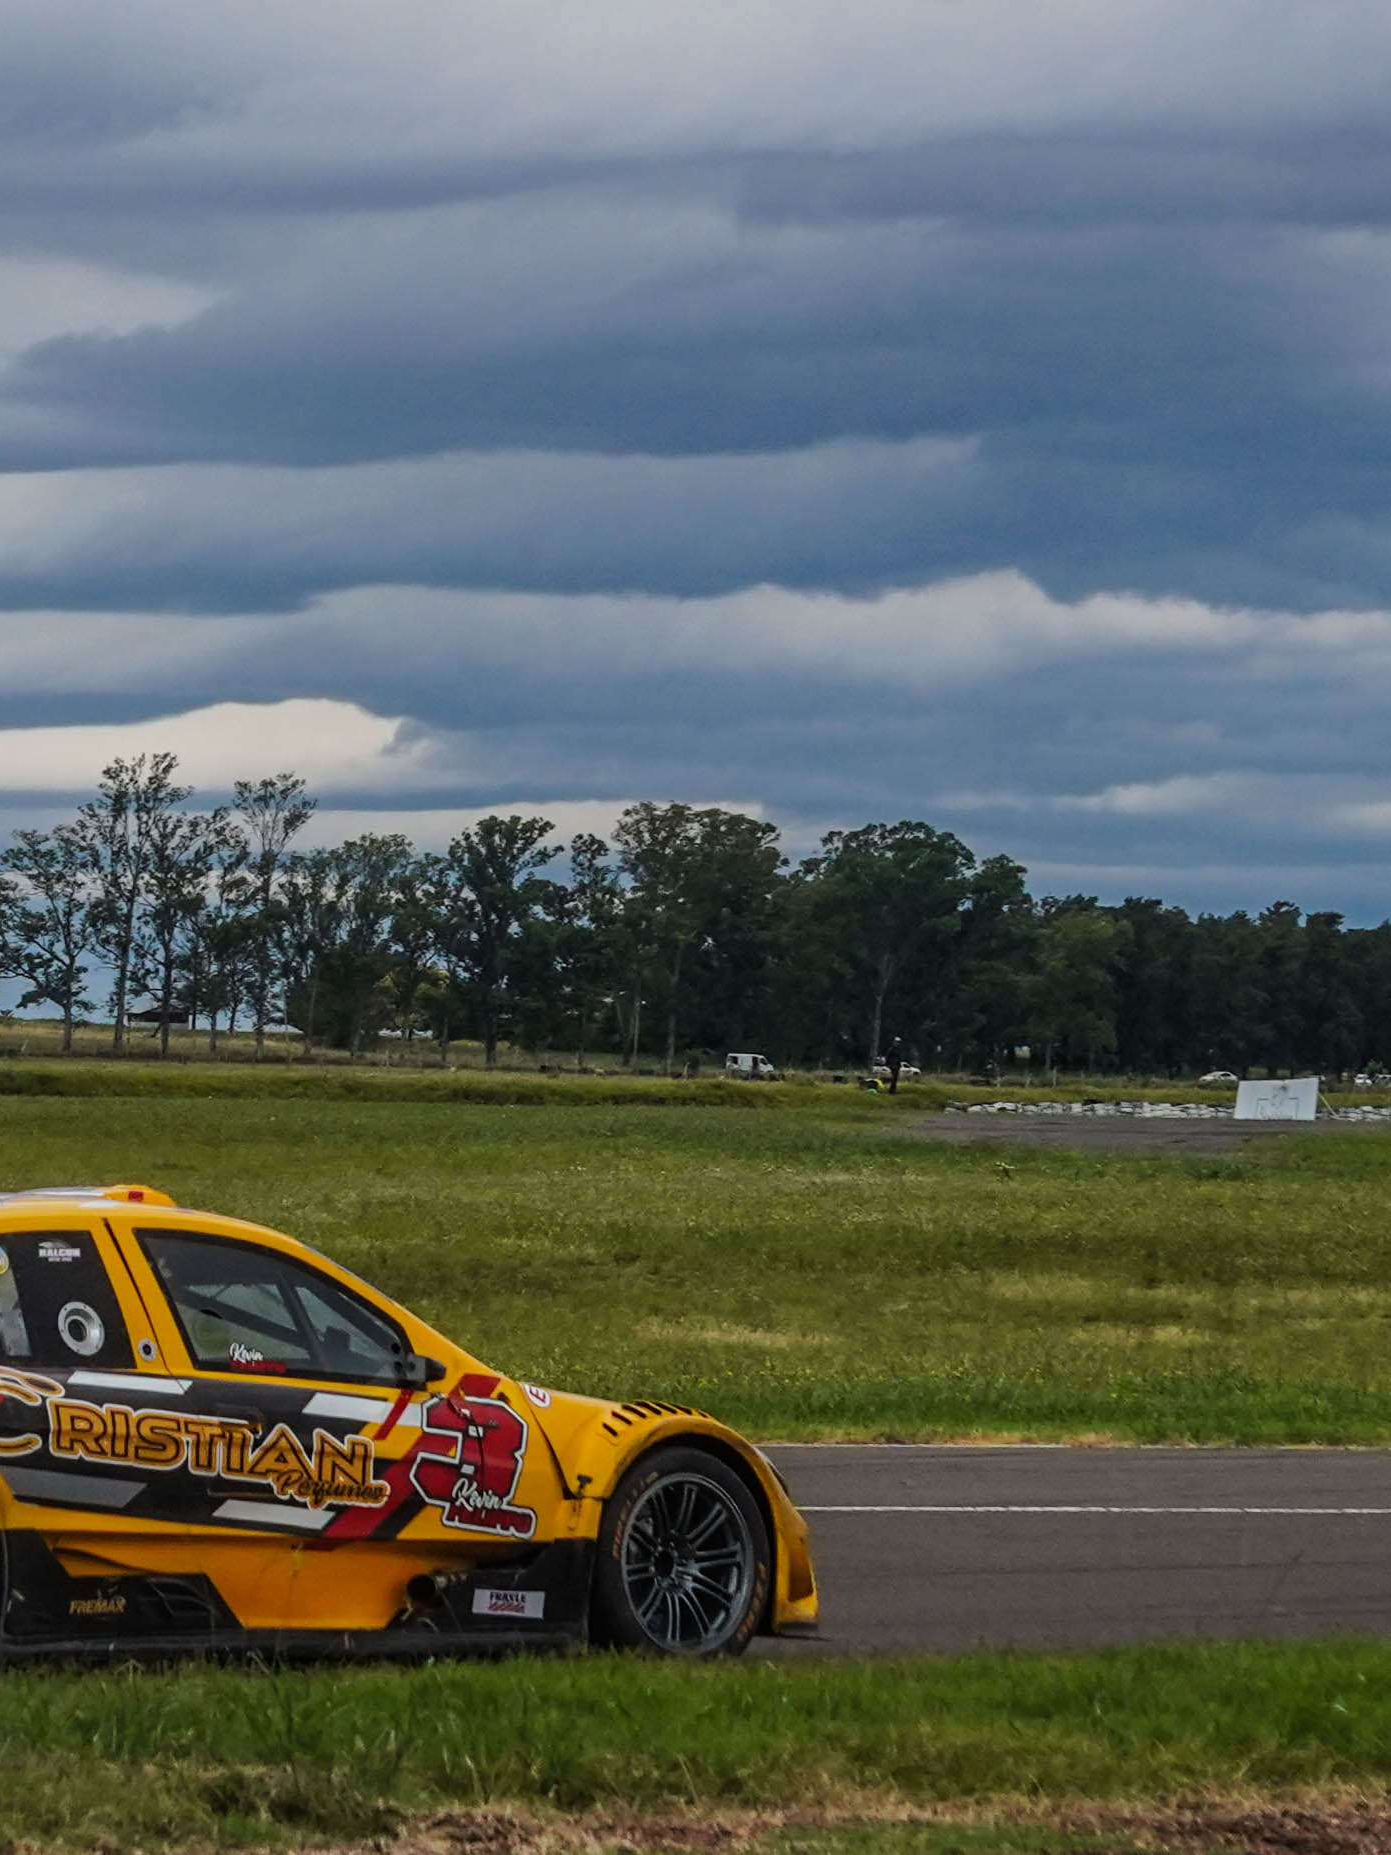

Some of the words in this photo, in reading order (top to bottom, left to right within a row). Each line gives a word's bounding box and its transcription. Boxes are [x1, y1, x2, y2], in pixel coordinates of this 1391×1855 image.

[229, 1342, 264, 1364] Kevin
[410, 1395, 528, 1512] 3
[274, 1468, 389, 1505] Perfumes
[452, 1478, 503, 1512] Kevin
